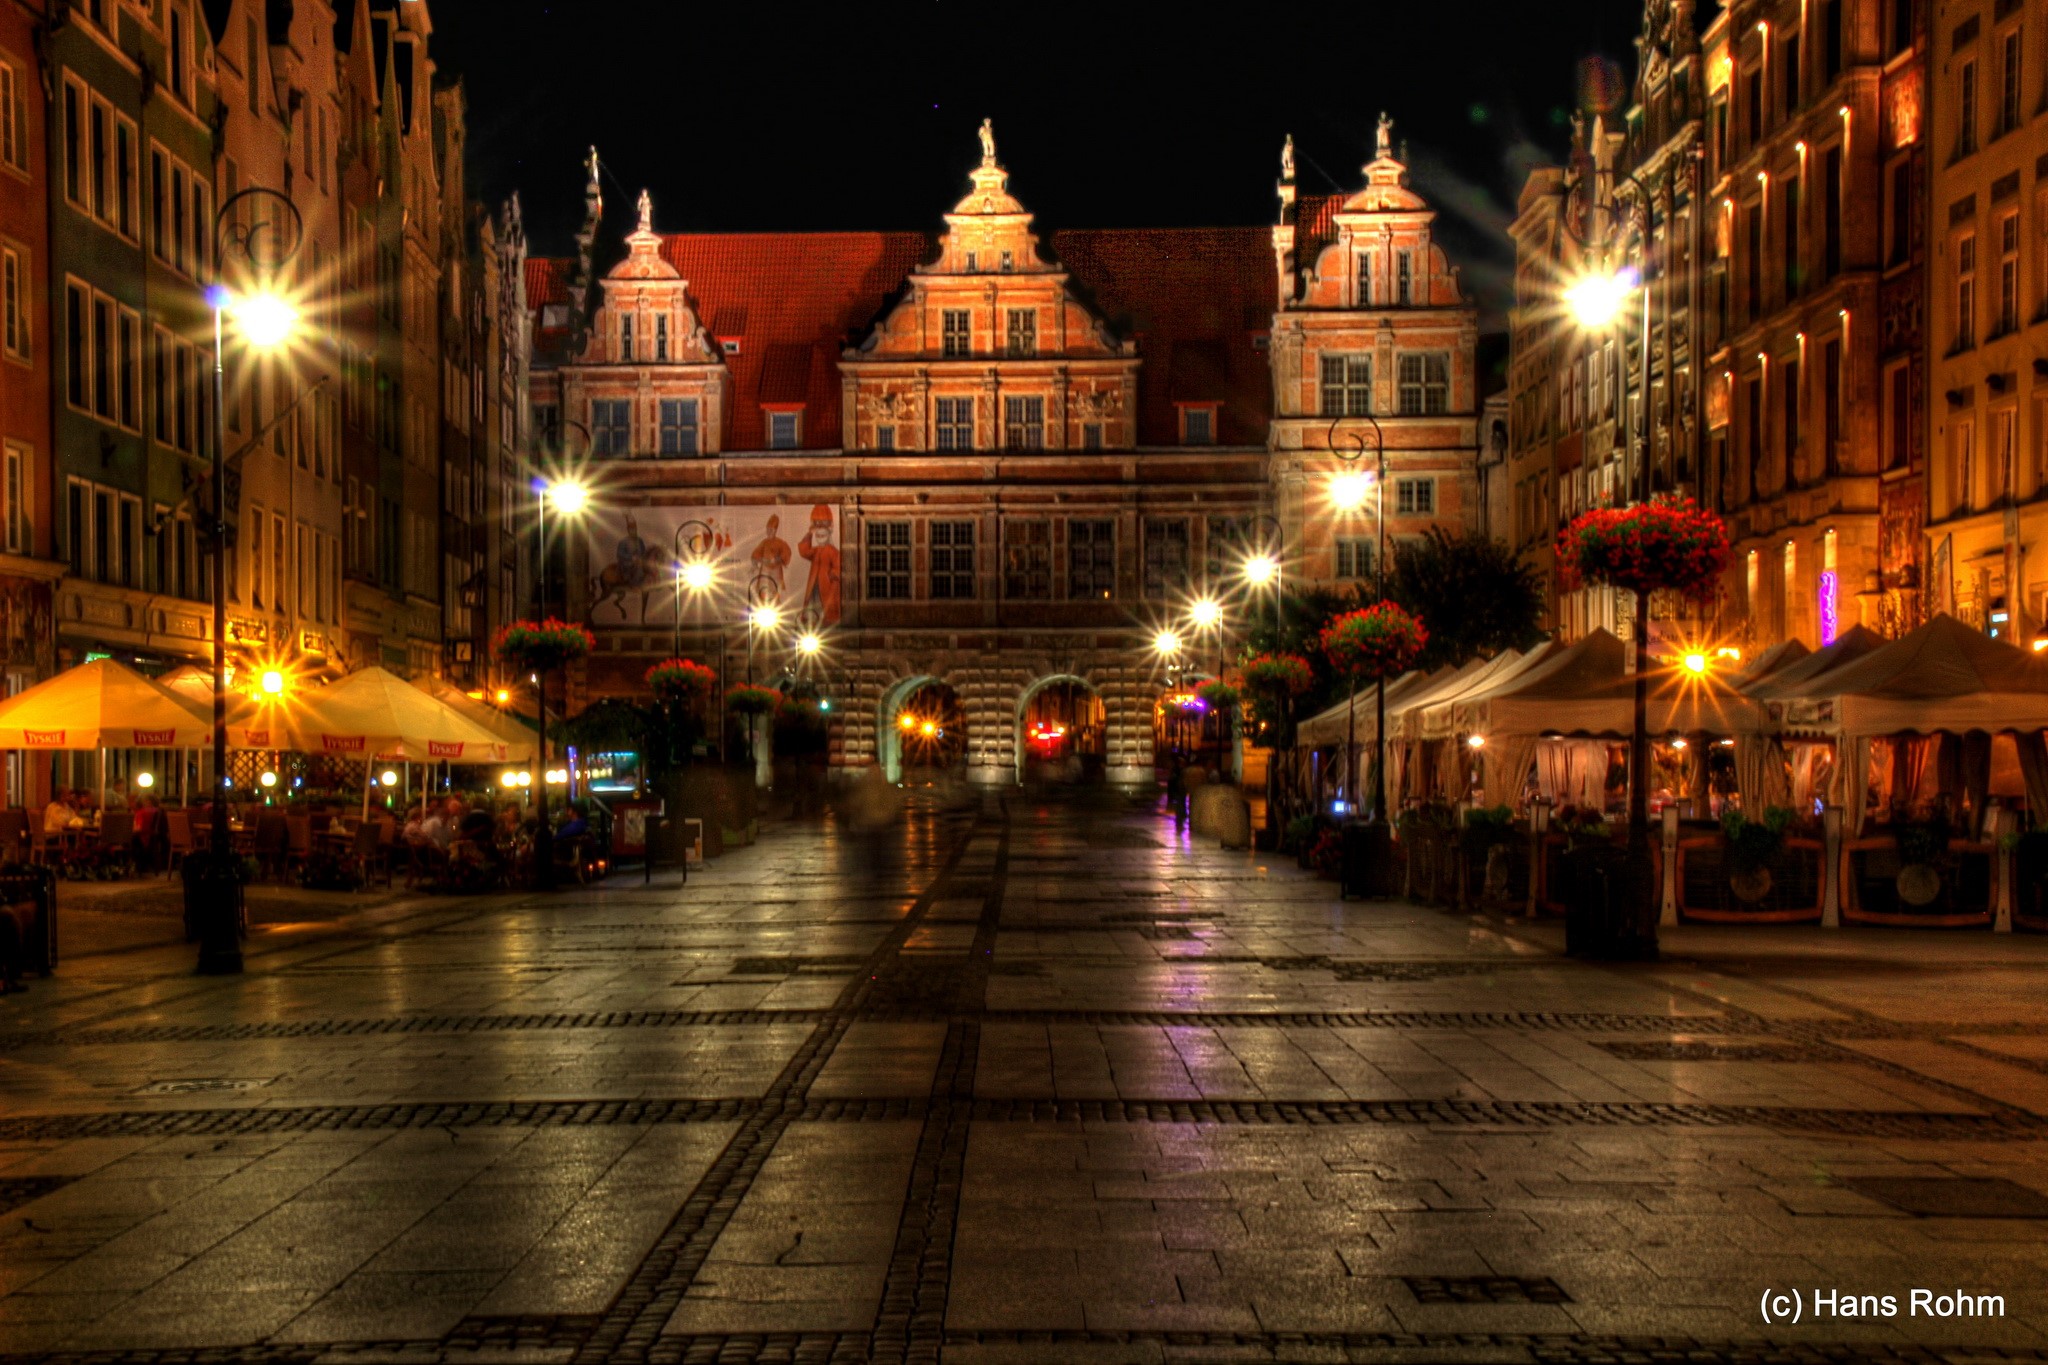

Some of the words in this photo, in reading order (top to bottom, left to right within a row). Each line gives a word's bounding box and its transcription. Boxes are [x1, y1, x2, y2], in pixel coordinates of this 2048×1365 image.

[28, 733, 62, 744] TYSKIE
[138, 732, 172, 744] TYSKIE
[431, 743, 459, 756] TYSKIE
